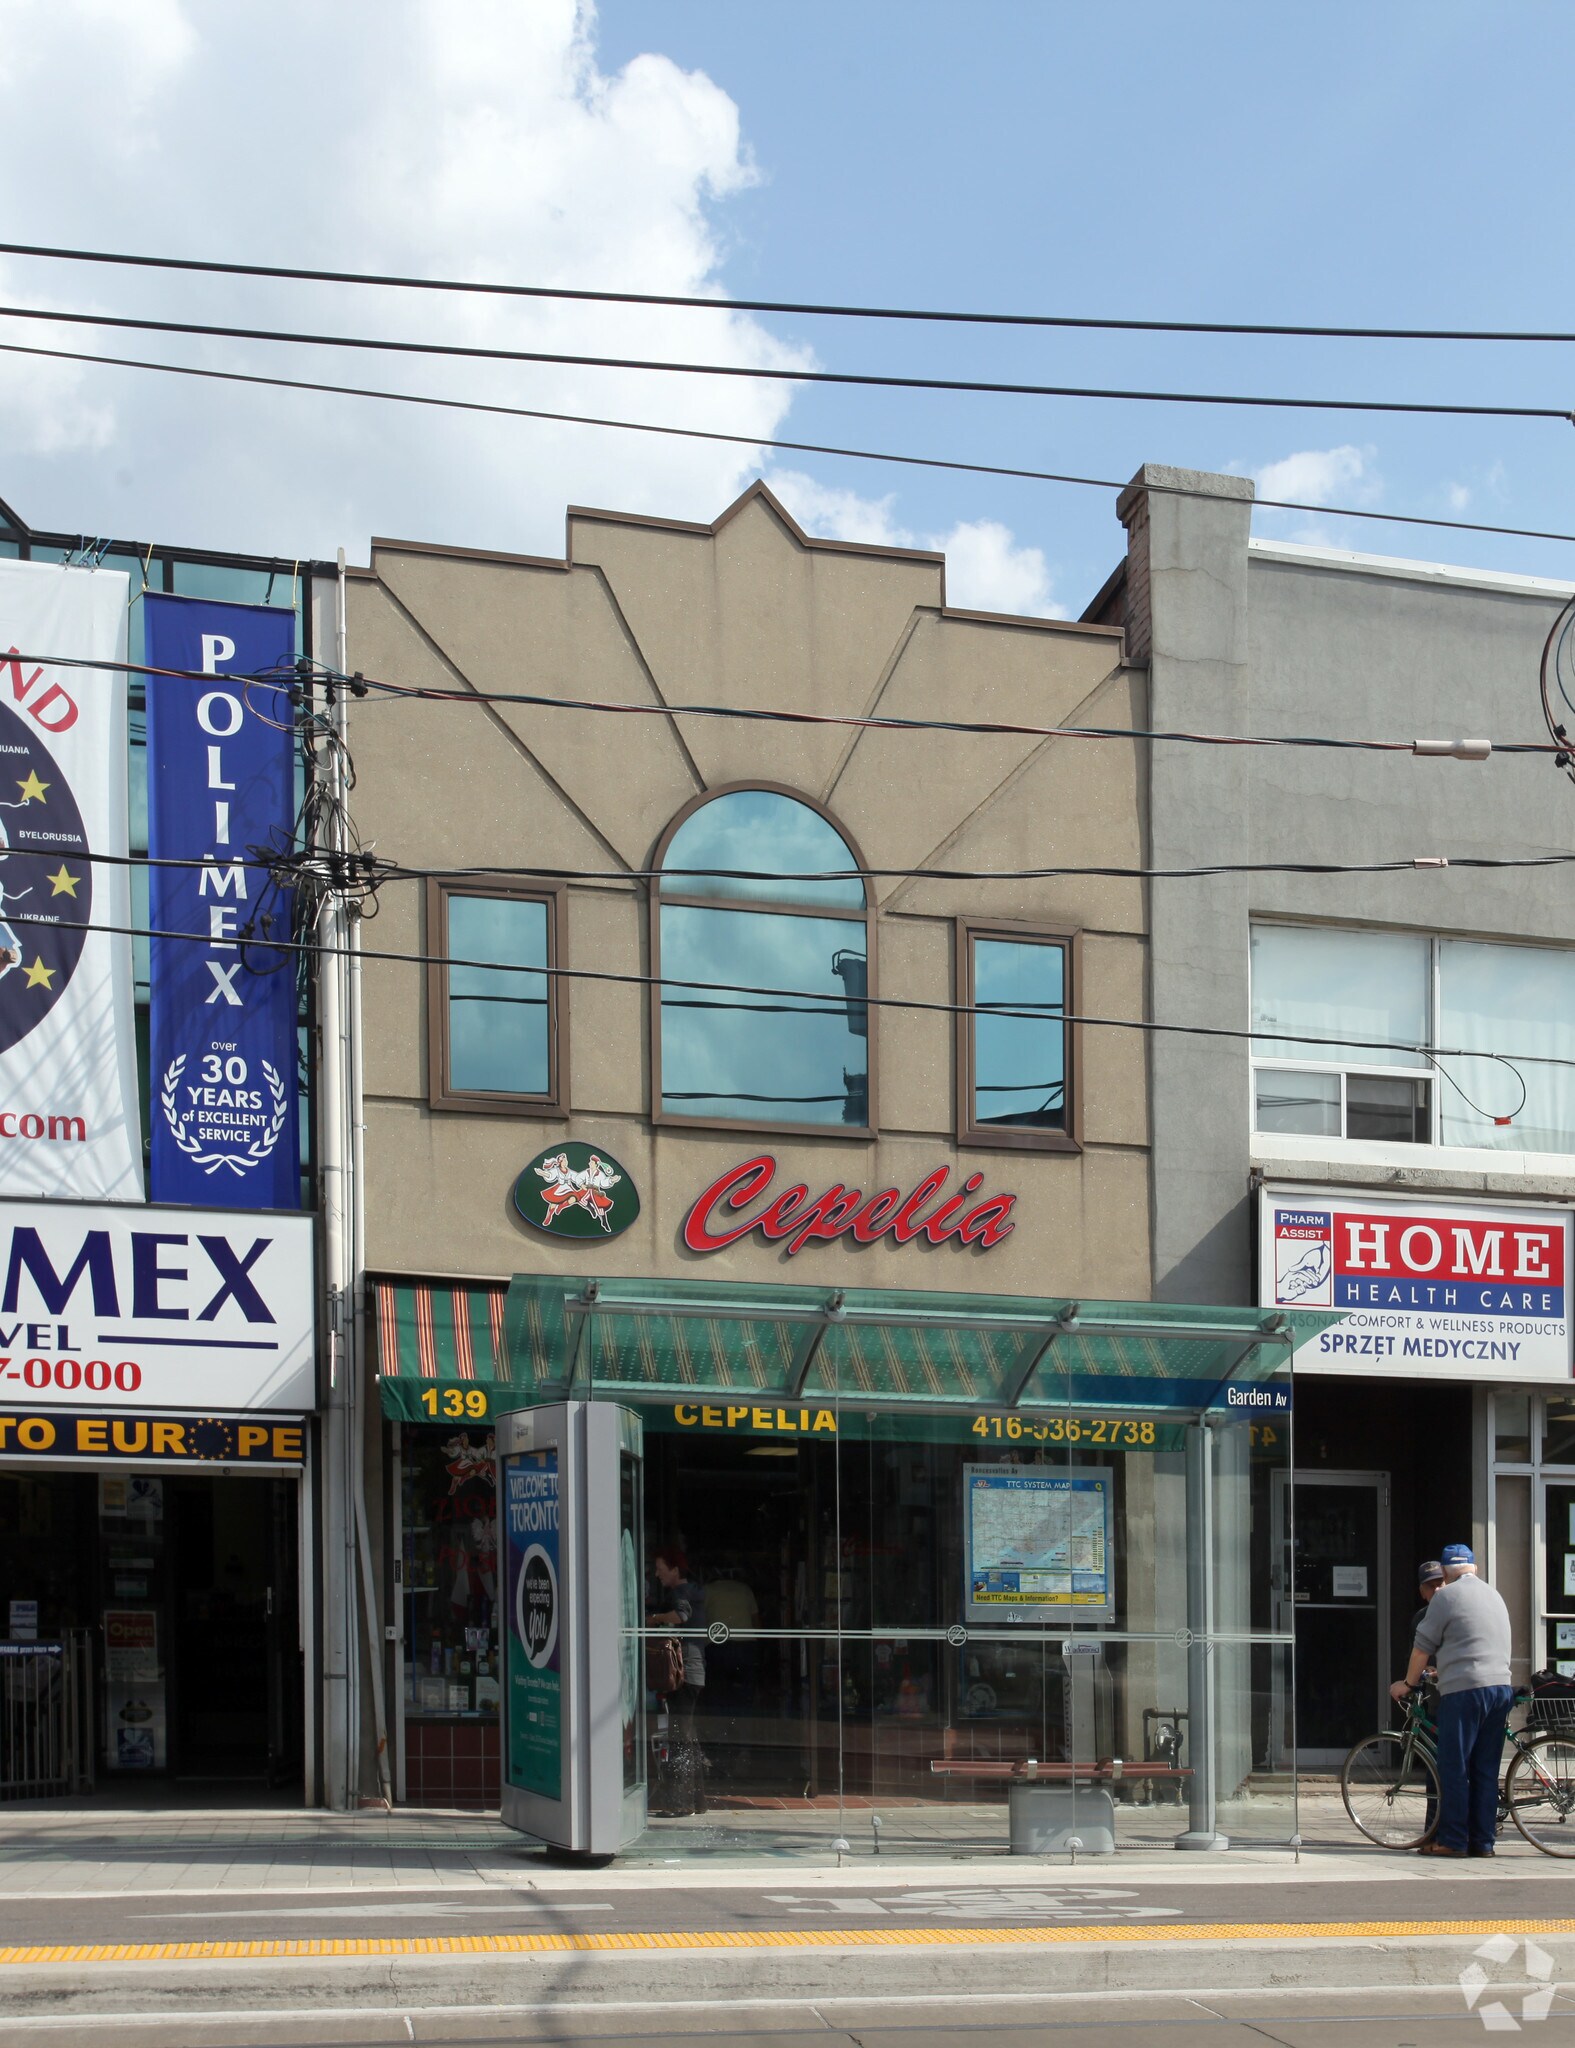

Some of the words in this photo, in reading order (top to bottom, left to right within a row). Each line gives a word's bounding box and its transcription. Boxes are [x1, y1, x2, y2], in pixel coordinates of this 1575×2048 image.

[197, 633, 248, 1007] POLIMEX
[19, 830, 82, 843] BYELORUSSIA
[211, 1041, 237, 1051] over
[201, 1054, 247, 1085] 30
[187, 1086, 263, 1110] YEARS
[182, 1109, 195, 1122] of
[198, 1110, 267, 1127] EXCELLENT
[198, 1127, 251, 1142] SERVICE
[684, 1155, 1018, 1256] Cepelia
[1345, 1222, 1550, 1278] HOME
[1, 1226, 277, 1324] MEX
[1347, 1283, 1457, 1306] HEALTH
[1480, 1290, 1551, 1311] CARE
[1289, 1312, 1343, 1327] RSONAL
[1349, 1314, 1411, 1329] COMFORT
[1416, 1317, 1425, 1329] &
[1430, 1318, 1494, 1333] WELLNESS
[1499, 1322, 1566, 1337] PRODUCTS
[1403, 1338, 1521, 1361] MEDYCZNY
[422, 1388, 487, 1418] 139
[1228, 1387, 1271, 1406] Garden
[1275, 1397, 1287, 1406] Av
[674, 1404, 837, 1432] CEPELIA
[0, 1417, 56, 1450] TO
[510, 1475, 548, 1499] WELCOME
[110, 1623, 152, 1638] Open
